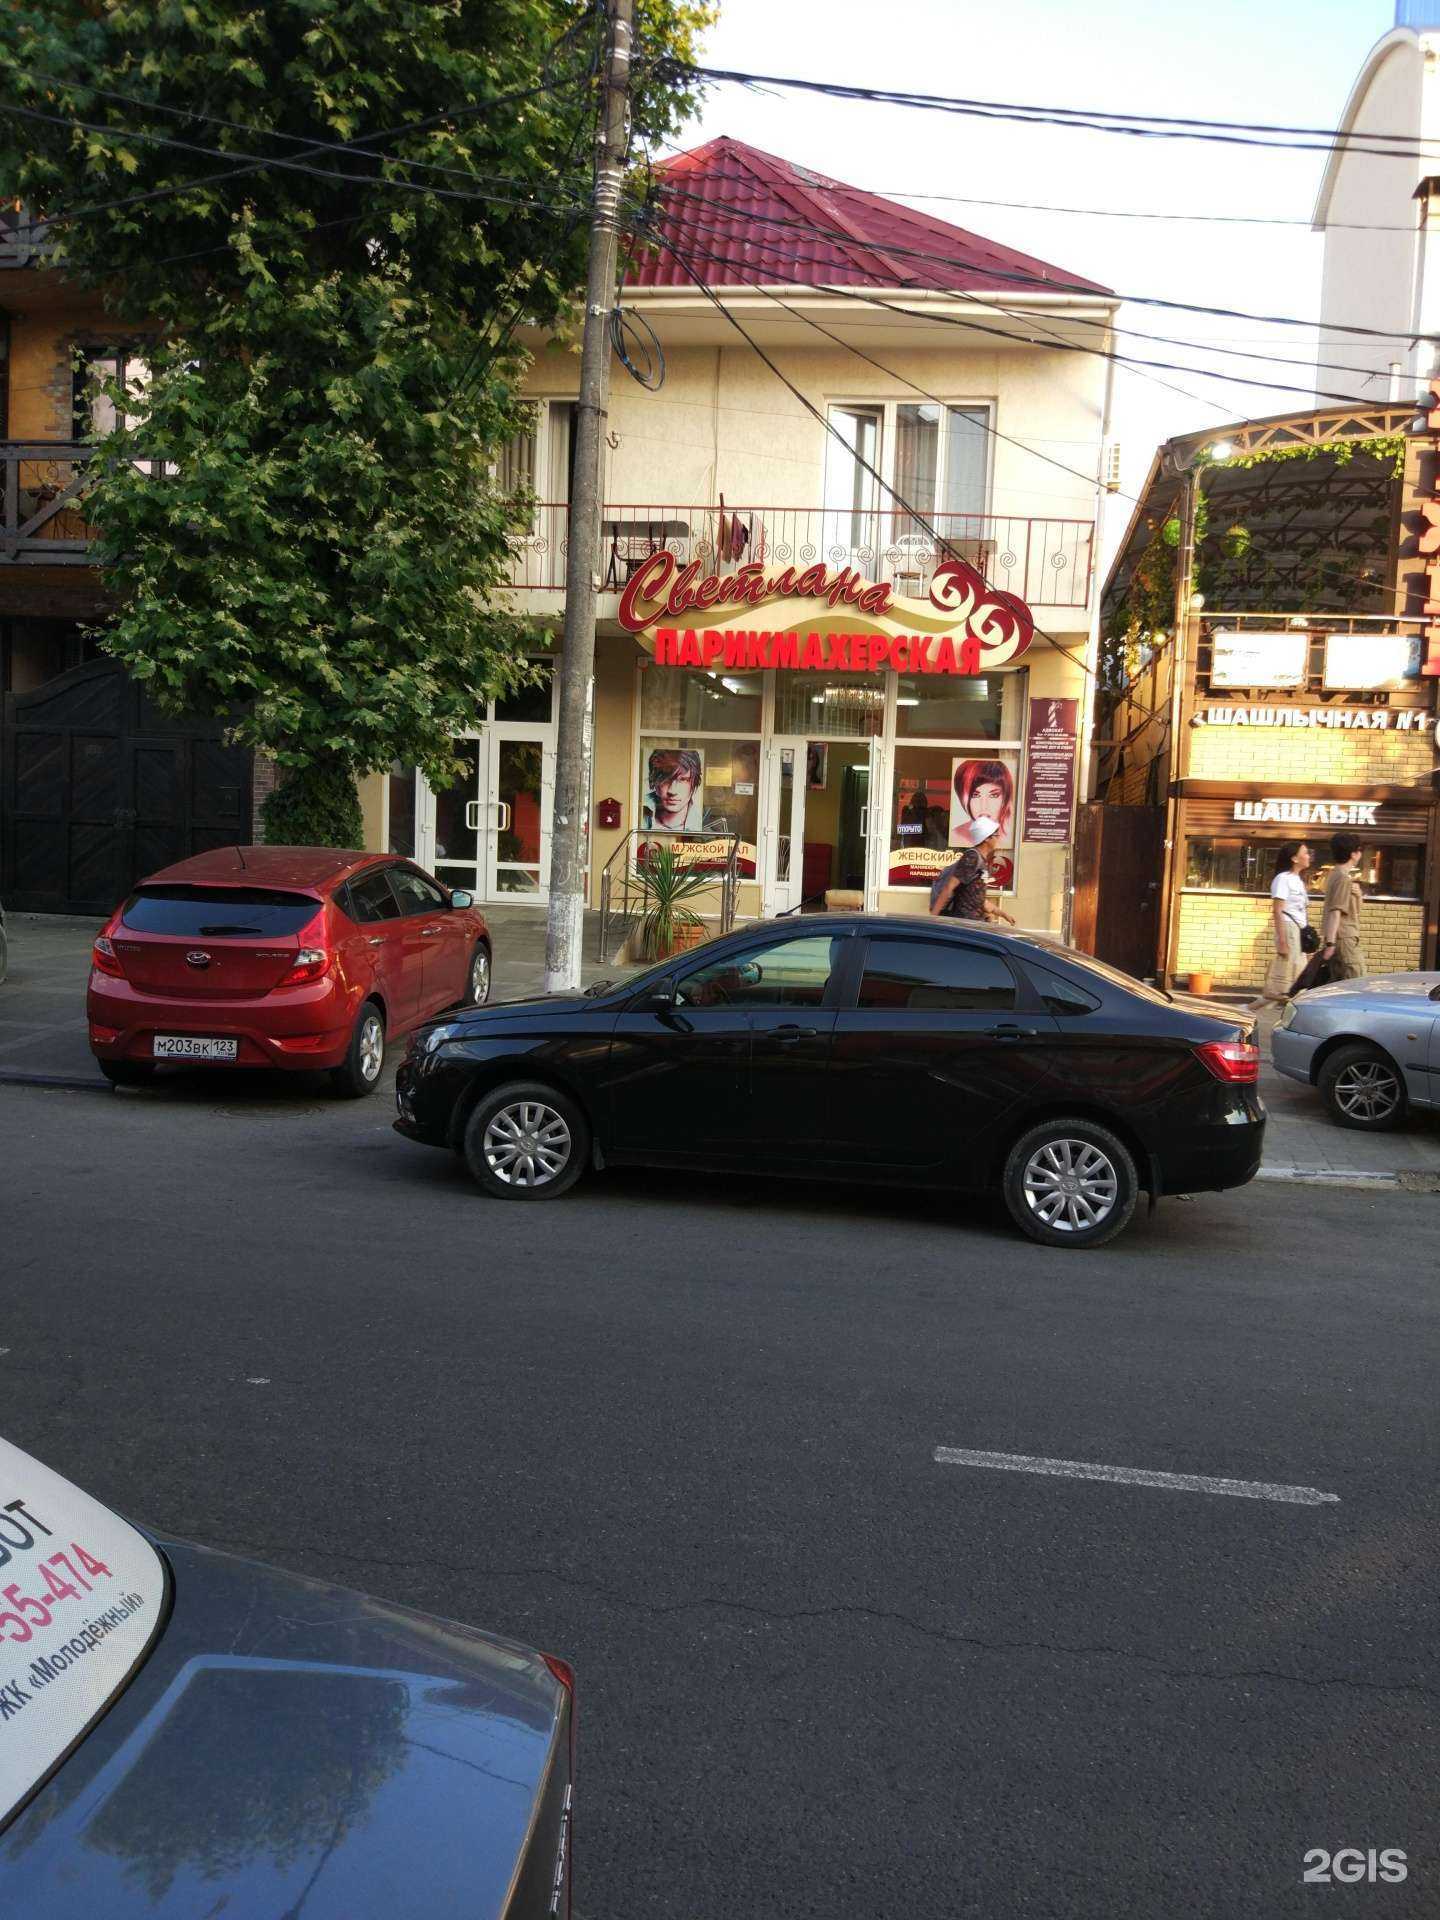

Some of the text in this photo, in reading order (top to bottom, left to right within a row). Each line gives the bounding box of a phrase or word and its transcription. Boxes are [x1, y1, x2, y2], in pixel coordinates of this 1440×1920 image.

[617, 550, 894, 632] Светлана
[655, 628, 982, 675] ПАРИКМАХЕРСКАЯ
[1207, 707, 1389, 730] ШАШЛЫЧНАЯ
[1233, 801, 1378, 825] ШАШЛЫК
[898, 851, 952, 862] ЖЕНСКИЙ
[213, 1040, 234, 1052] 123
[28, 1591, 146, 1690] «Молодёжный»
